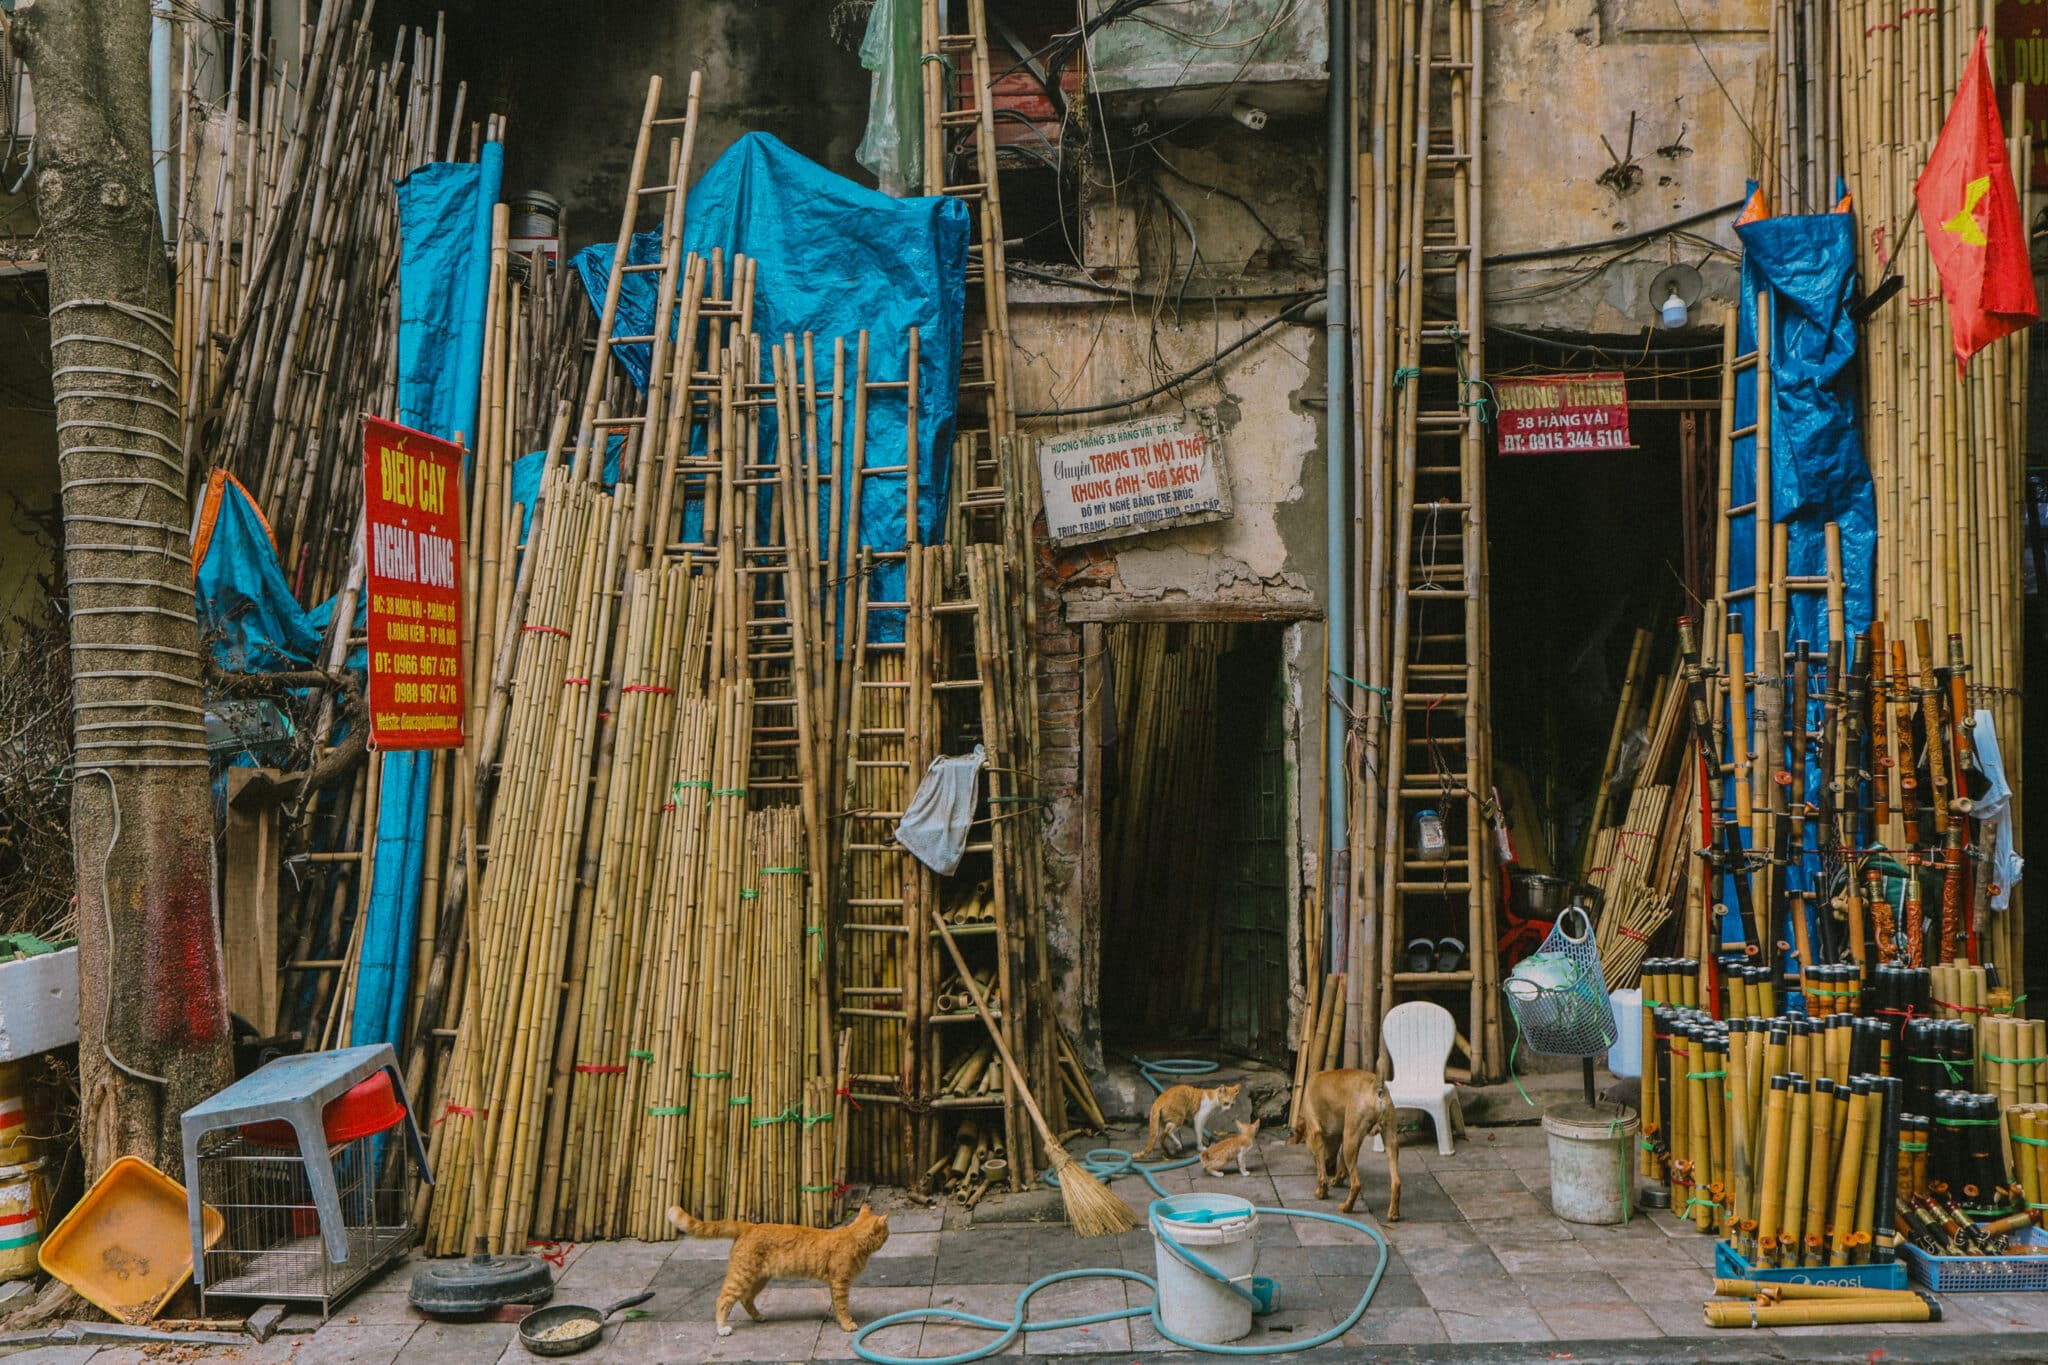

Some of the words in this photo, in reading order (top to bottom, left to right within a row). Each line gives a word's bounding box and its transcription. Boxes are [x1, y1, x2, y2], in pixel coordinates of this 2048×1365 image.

[2015, 28, 2048, 86] DŨ
[1498, 384, 1560, 411] HƯƠNG
[1516, 416, 1535, 429] 38
[1537, 412, 1581, 428] HÀNG
[1583, 409, 1609, 425] VẢI
[1051, 440, 1079, 454] HƯƠNG
[1107, 433, 1117, 444] 38
[1117, 428, 1139, 442] HÀNG
[1504, 433, 1526, 452] ĐT:
[1529, 432, 1563, 451] 0915
[1567, 430, 1593, 449] 344
[1597, 429, 1623, 449] 510
[1054, 459, 1091, 481] Chuyên
[1089, 449, 1130, 475] TRANG
[1131, 441, 1152, 467] TRÍ
[1152, 438, 1176, 466] NỘI
[1176, 431, 1207, 459] THẤT
[380, 436, 415, 509] ĐIẾU
[418, 452, 446, 516] CÀY
[1071, 479, 1112, 504] KHUNG
[1114, 471, 1141, 497] ẢNH
[1146, 464, 1168, 490] GIÁ
[1168, 462, 1200, 486] SÁCH
[1109, 497, 1131, 513] NGHỆ
[1156, 491, 1172, 504] TRE
[1173, 486, 1194, 501] TRÚC
[1080, 519, 1106, 534] TRANH
[373, 518, 417, 584] NGHĨA
[419, 525, 455, 589] DŨNG
[375, 651, 392, 673] ĐT:
[394, 654, 418, 675] 0966
[420, 655, 438, 676] 967
[439, 657, 457, 678] 476
[394, 682, 418, 704] 0988
[420, 683, 438, 704] 967
[439, 684, 457, 704] 476
